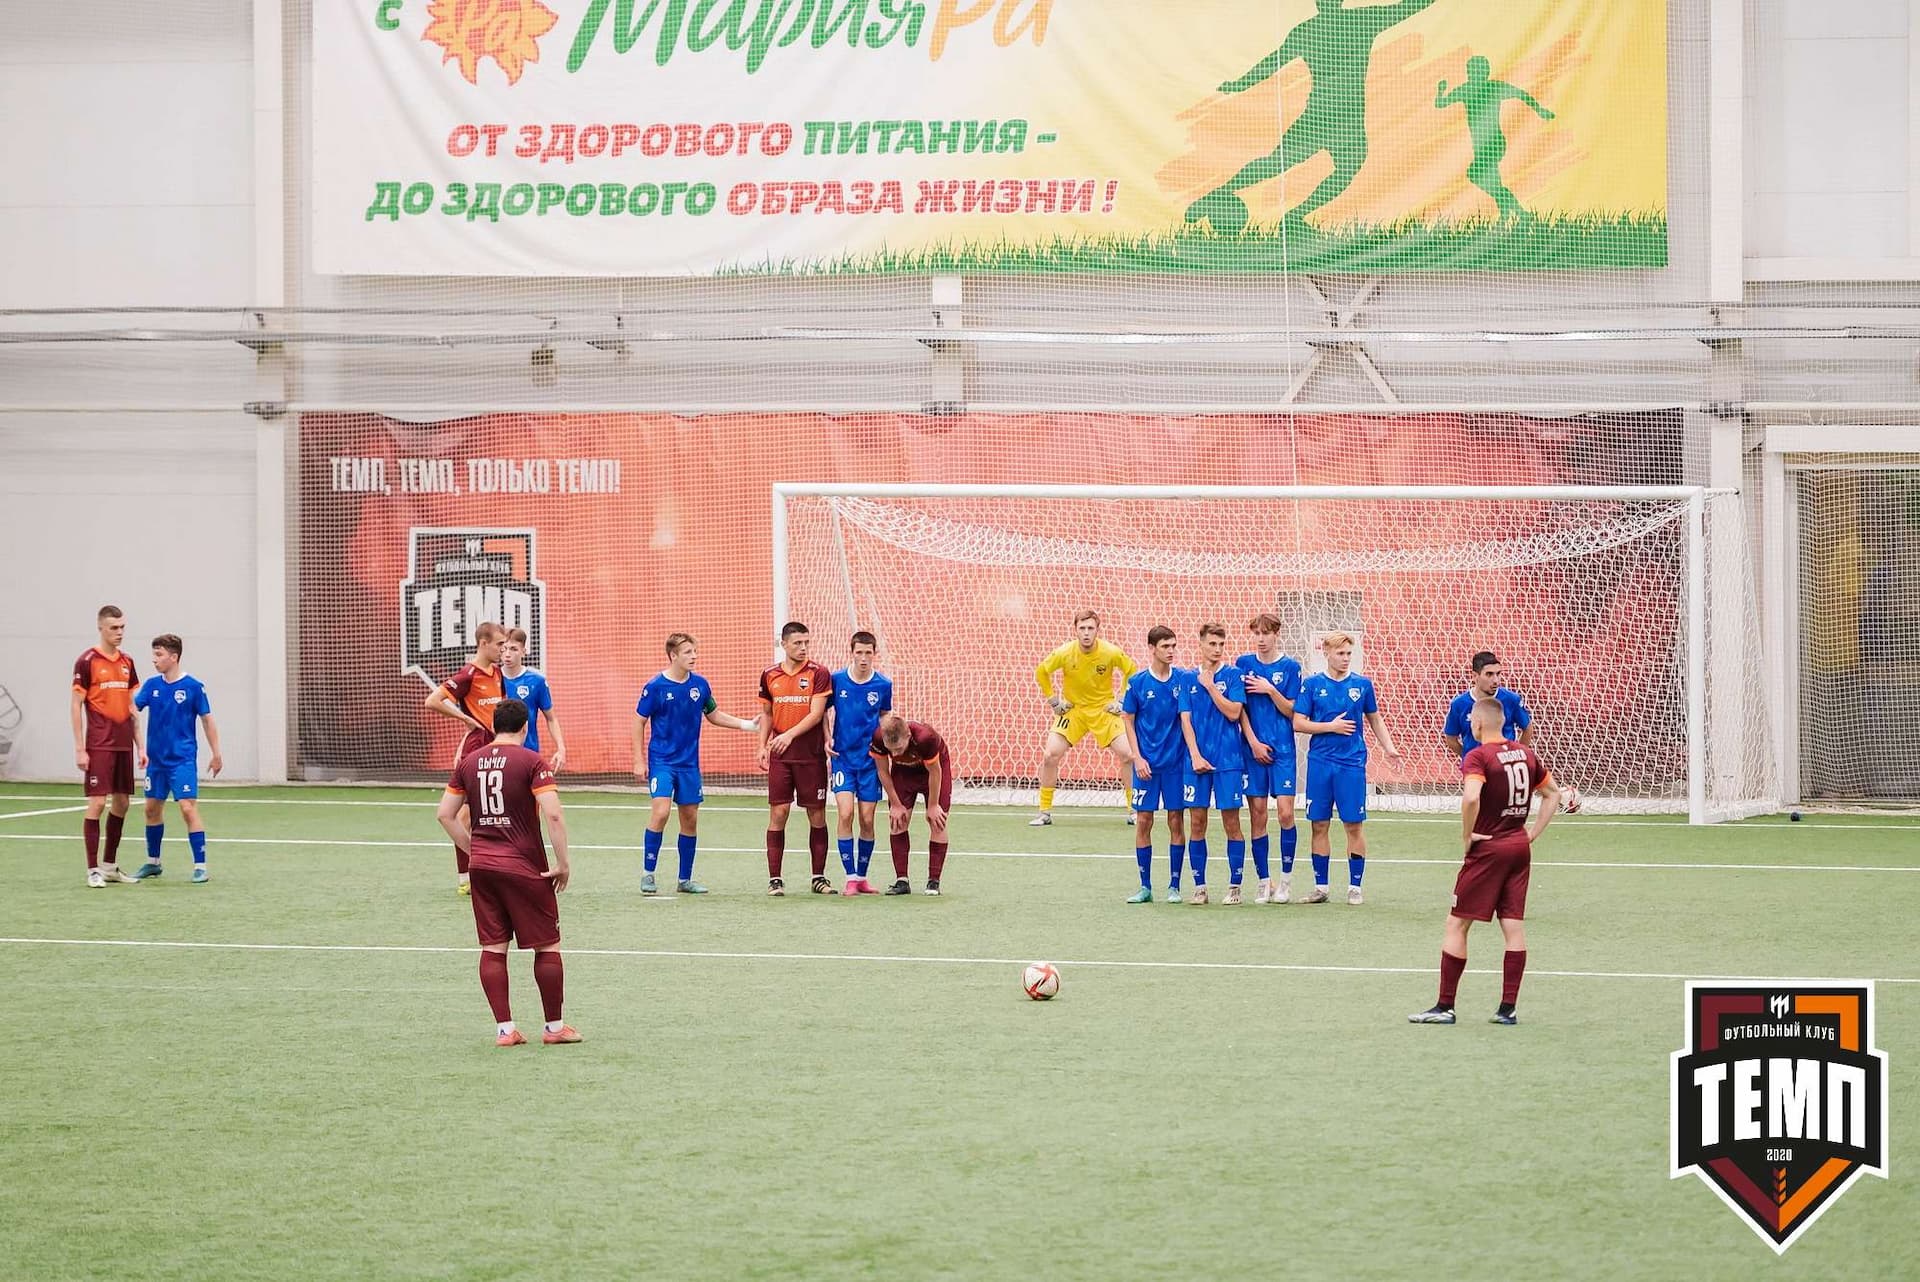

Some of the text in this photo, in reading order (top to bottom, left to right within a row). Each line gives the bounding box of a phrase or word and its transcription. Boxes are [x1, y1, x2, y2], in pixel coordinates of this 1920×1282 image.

[446, 122, 508, 158] ОТ
[514, 122, 793, 165] ЗДОРОВОГО
[803, 119, 1029, 156] ПИТАНИЯ
[365, 181, 434, 222] ДО
[440, 181, 717, 223] ЗДОРОВОГО
[726, 180, 905, 216] ОБРАЗА
[330, 457, 621, 496] ТЕМП, ТЕМП, ТОЛЬКО ТЕМП!
[414, 585, 531, 653] ТЕМП
[477, 770, 504, 815] 13
[1132, 788, 1147, 806] 27
[1504, 762, 1529, 806] 19
[479, 816, 511, 826] SEUS
